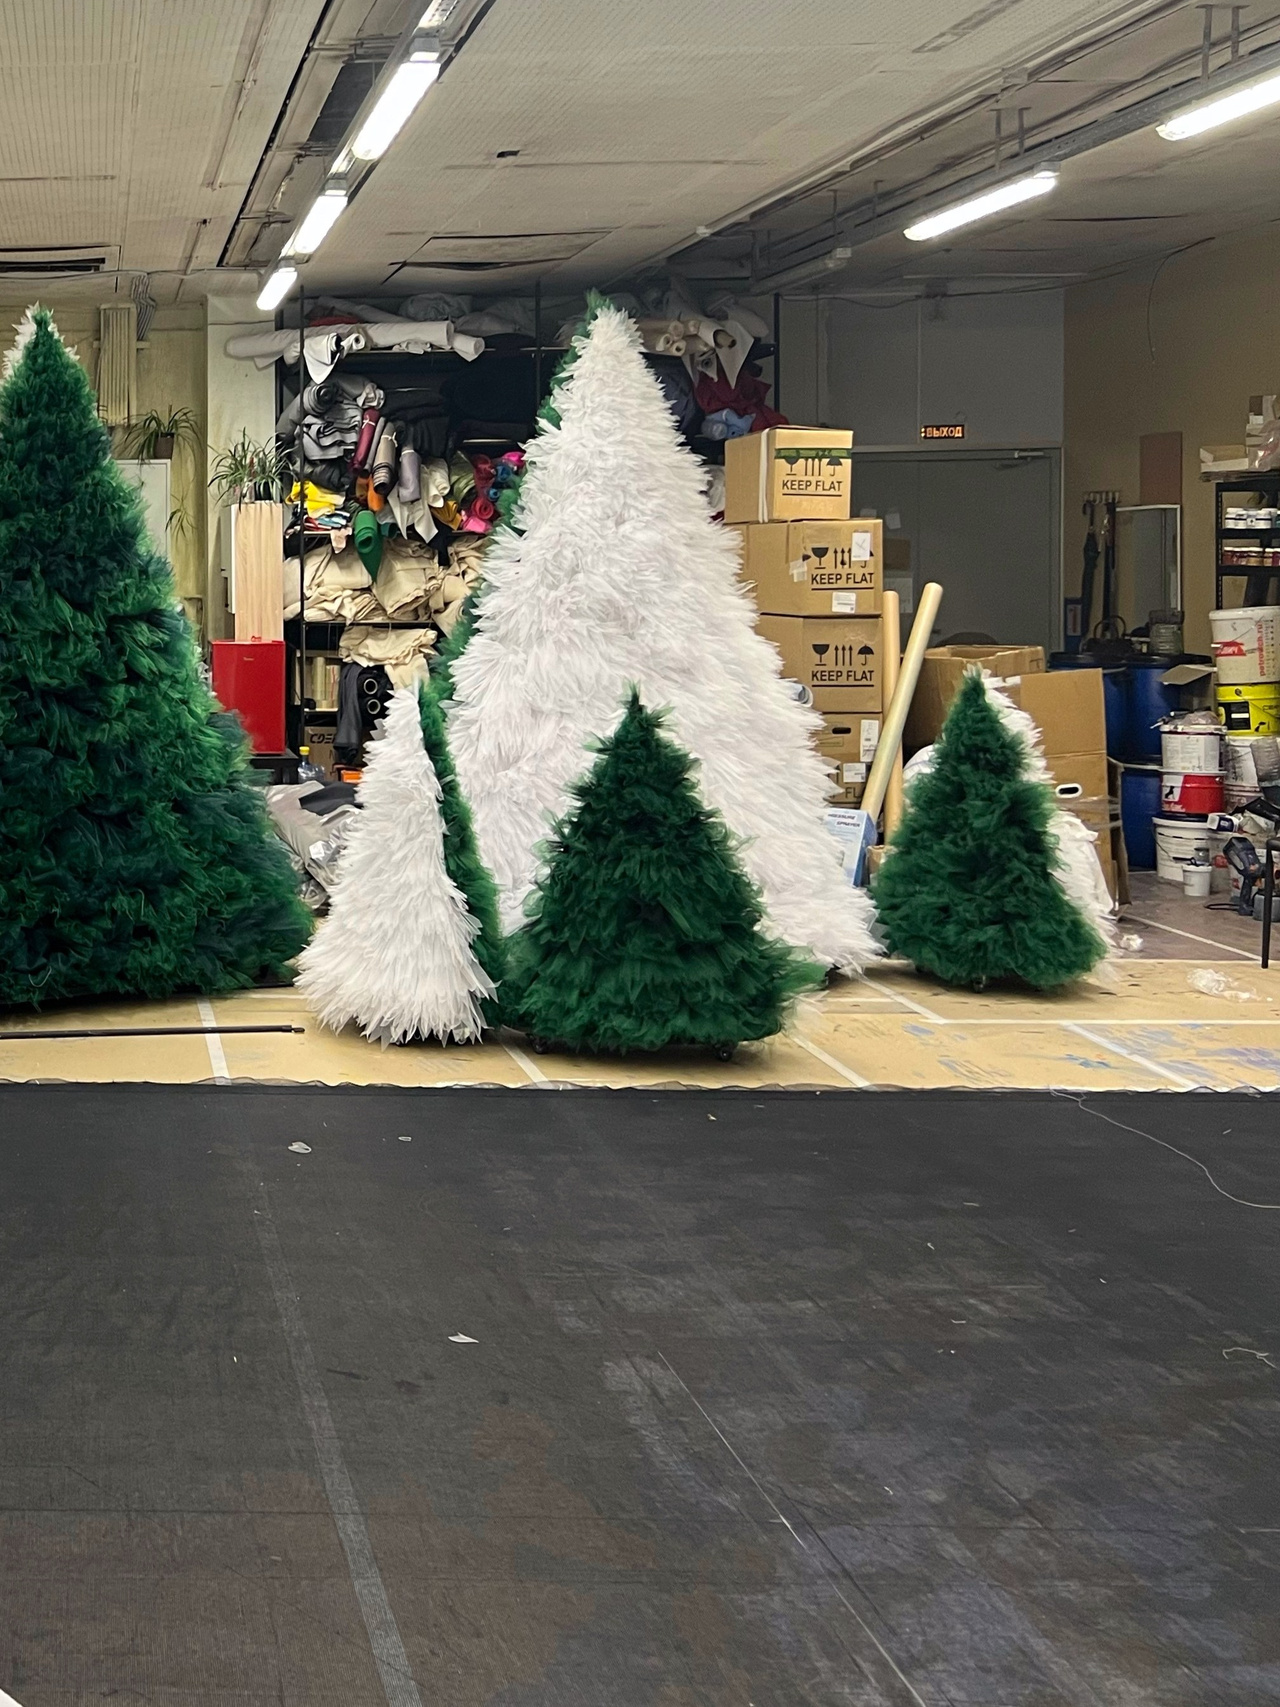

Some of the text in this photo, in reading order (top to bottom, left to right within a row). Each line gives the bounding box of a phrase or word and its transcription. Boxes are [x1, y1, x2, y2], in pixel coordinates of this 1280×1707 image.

[926, 426, 963, 438] ВЫХОД
[782, 480, 843, 492] KEEP FLAT
[811, 572, 875, 585] KEEP FLAT
[1257, 623, 1266, 677] petrovich.ru
[811, 670, 875, 682] KEEP FLAT
